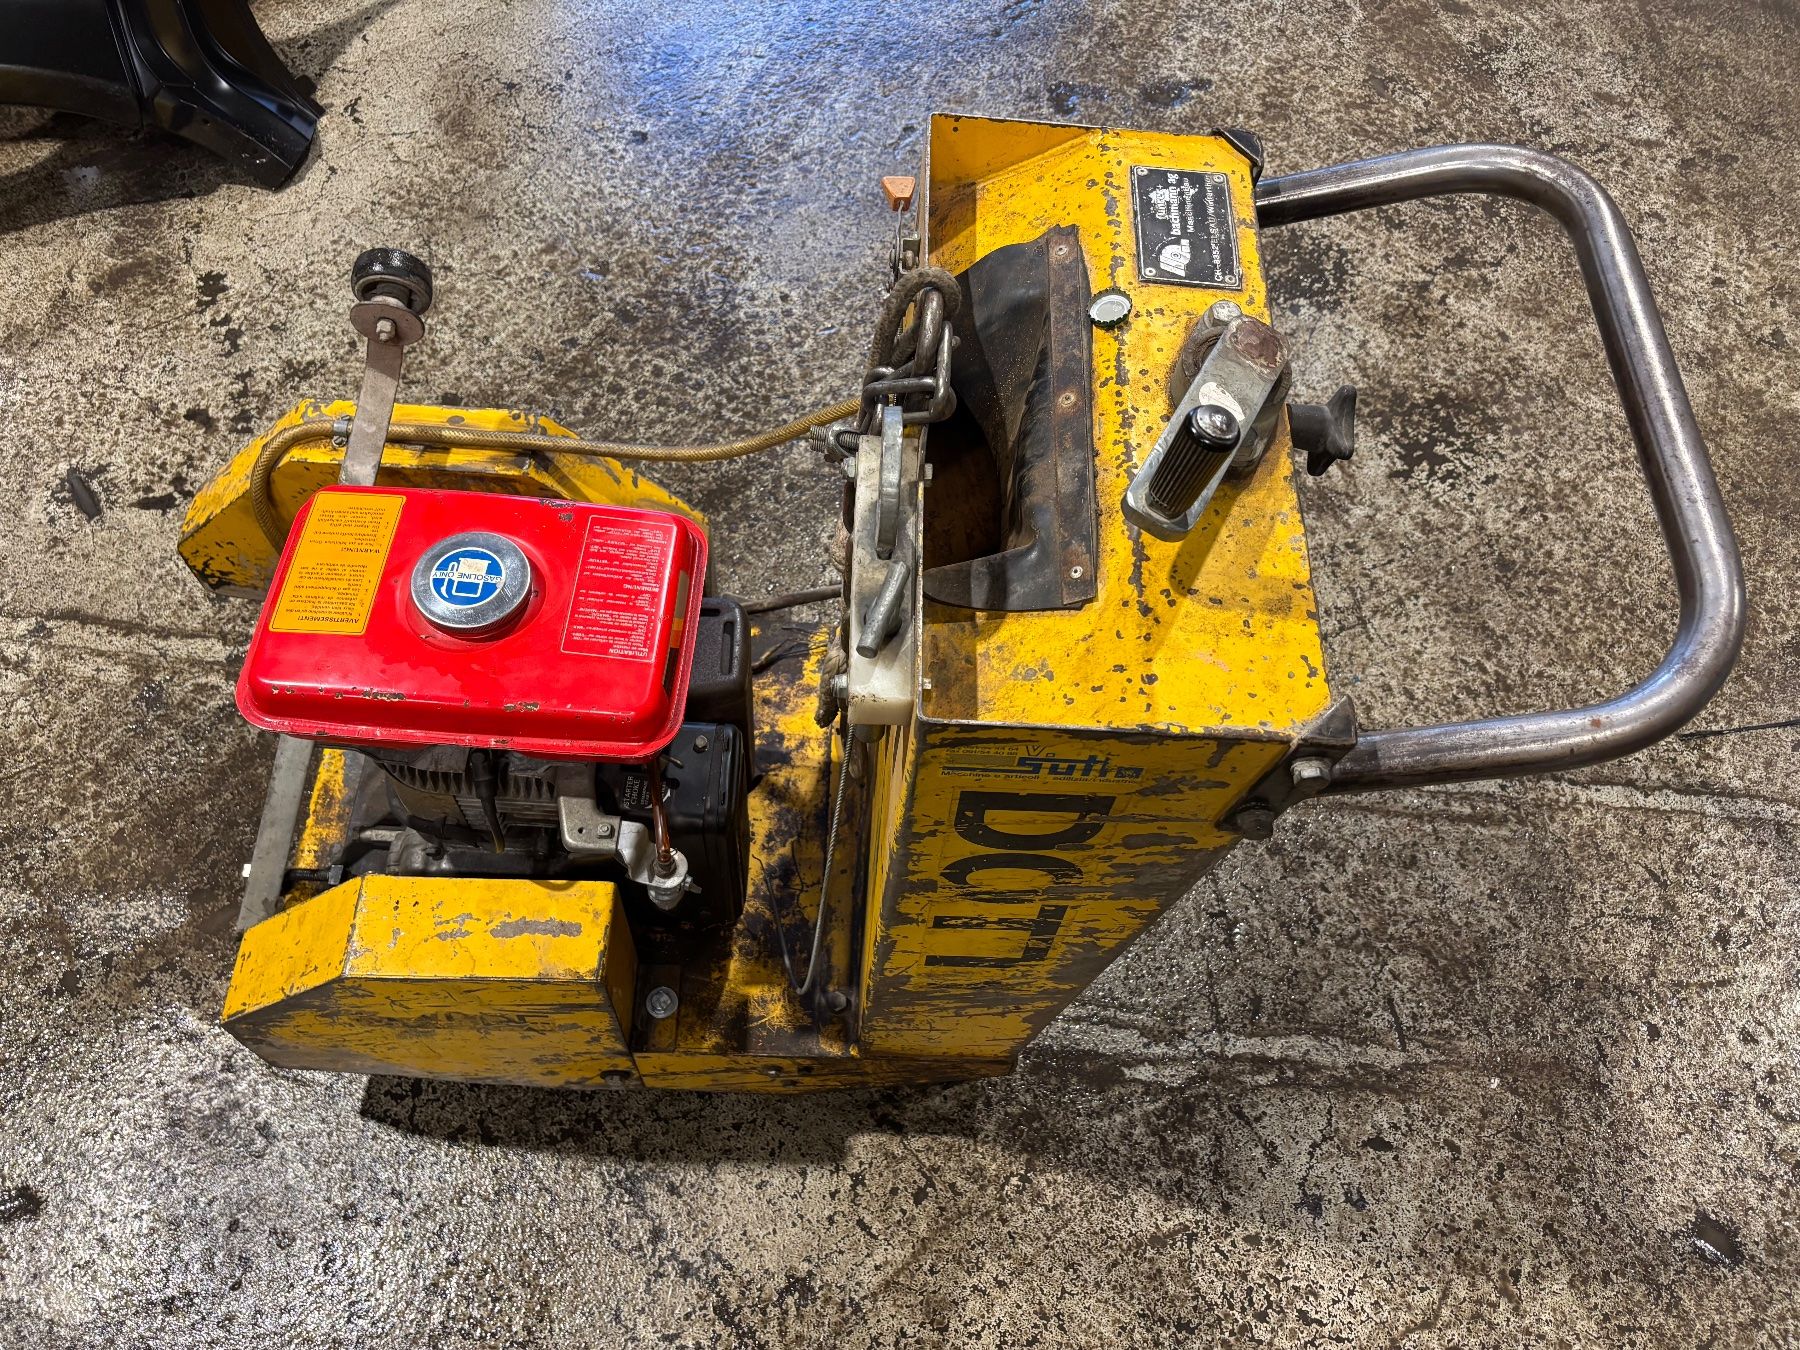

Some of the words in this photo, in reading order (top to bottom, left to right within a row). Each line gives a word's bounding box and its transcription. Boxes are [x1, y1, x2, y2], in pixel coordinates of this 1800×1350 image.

[1167, 173, 1179, 184] ag
[1168, 187, 1181, 235] bachmann
[457, 572, 502, 583] GASOLINE
[298, 615, 360, 624] AVERTISSEMENT!
[609, 648, 648, 657] UTILISATION
[624, 776, 634, 807] STARTER
[631, 779, 640, 805] CHOKE
